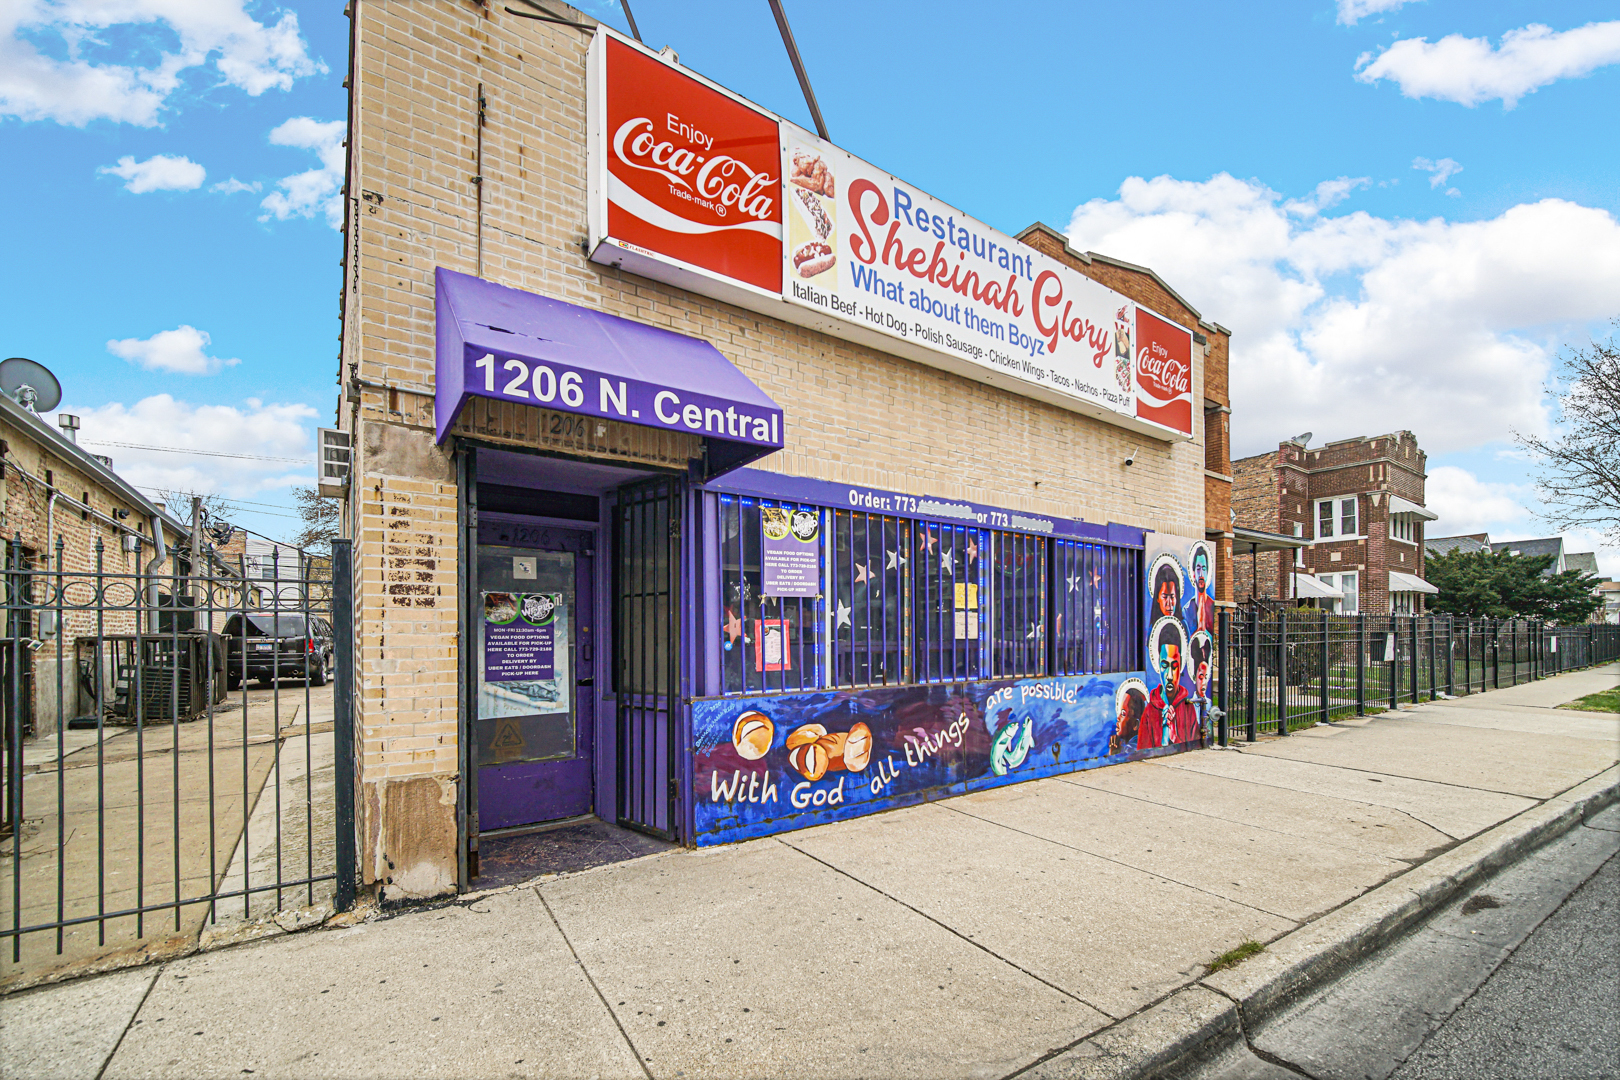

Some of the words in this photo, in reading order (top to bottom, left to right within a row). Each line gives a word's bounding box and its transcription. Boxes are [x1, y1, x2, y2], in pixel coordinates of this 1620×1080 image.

[613, 117, 778, 220] Coca-Cola
[667, 112, 714, 150] Enjoy
[848, 178, 1024, 317] Shekinah
[1032, 270, 1112, 368] Glory
[894, 186, 1032, 281] Restaurant
[793, 281, 828, 307] Italian
[831, 294, 856, 316] Beef
[866, 306, 884, 326] Hot
[886, 313, 906, 336] Dog
[915, 323, 944, 346] Polish
[946, 334, 982, 360] Sausage
[989, 350, 1020, 371] Chicken
[1022, 360, 1044, 380] Wings
[1050, 370, 1070, 388] Tacos
[1074, 378, 1098, 396] Nachos
[1102, 388, 1118, 404] Pizza
[1119, 394, 1130, 408] Puff
[850, 262, 904, 305] What
[910, 288, 960, 325] about
[964, 307, 1004, 340] them
[1008, 323, 1044, 356] Boyz
[1152, 341, 1168, 358] Enjoy
[474, 353, 584, 408] 1206
[600, 378, 639, 418] N.
[653, 390, 778, 444] Central
[1138, 346, 1190, 392] Coca-Cola
[848, 490, 890, 510] Order:
[977, 512, 988, 524] or
[711, 770, 778, 804] With
[790, 776, 844, 809] God
[870, 755, 900, 794] all
[904, 712, 970, 768] things
[986, 684, 1013, 710] are
[1020, 682, 1078, 704] possible!
